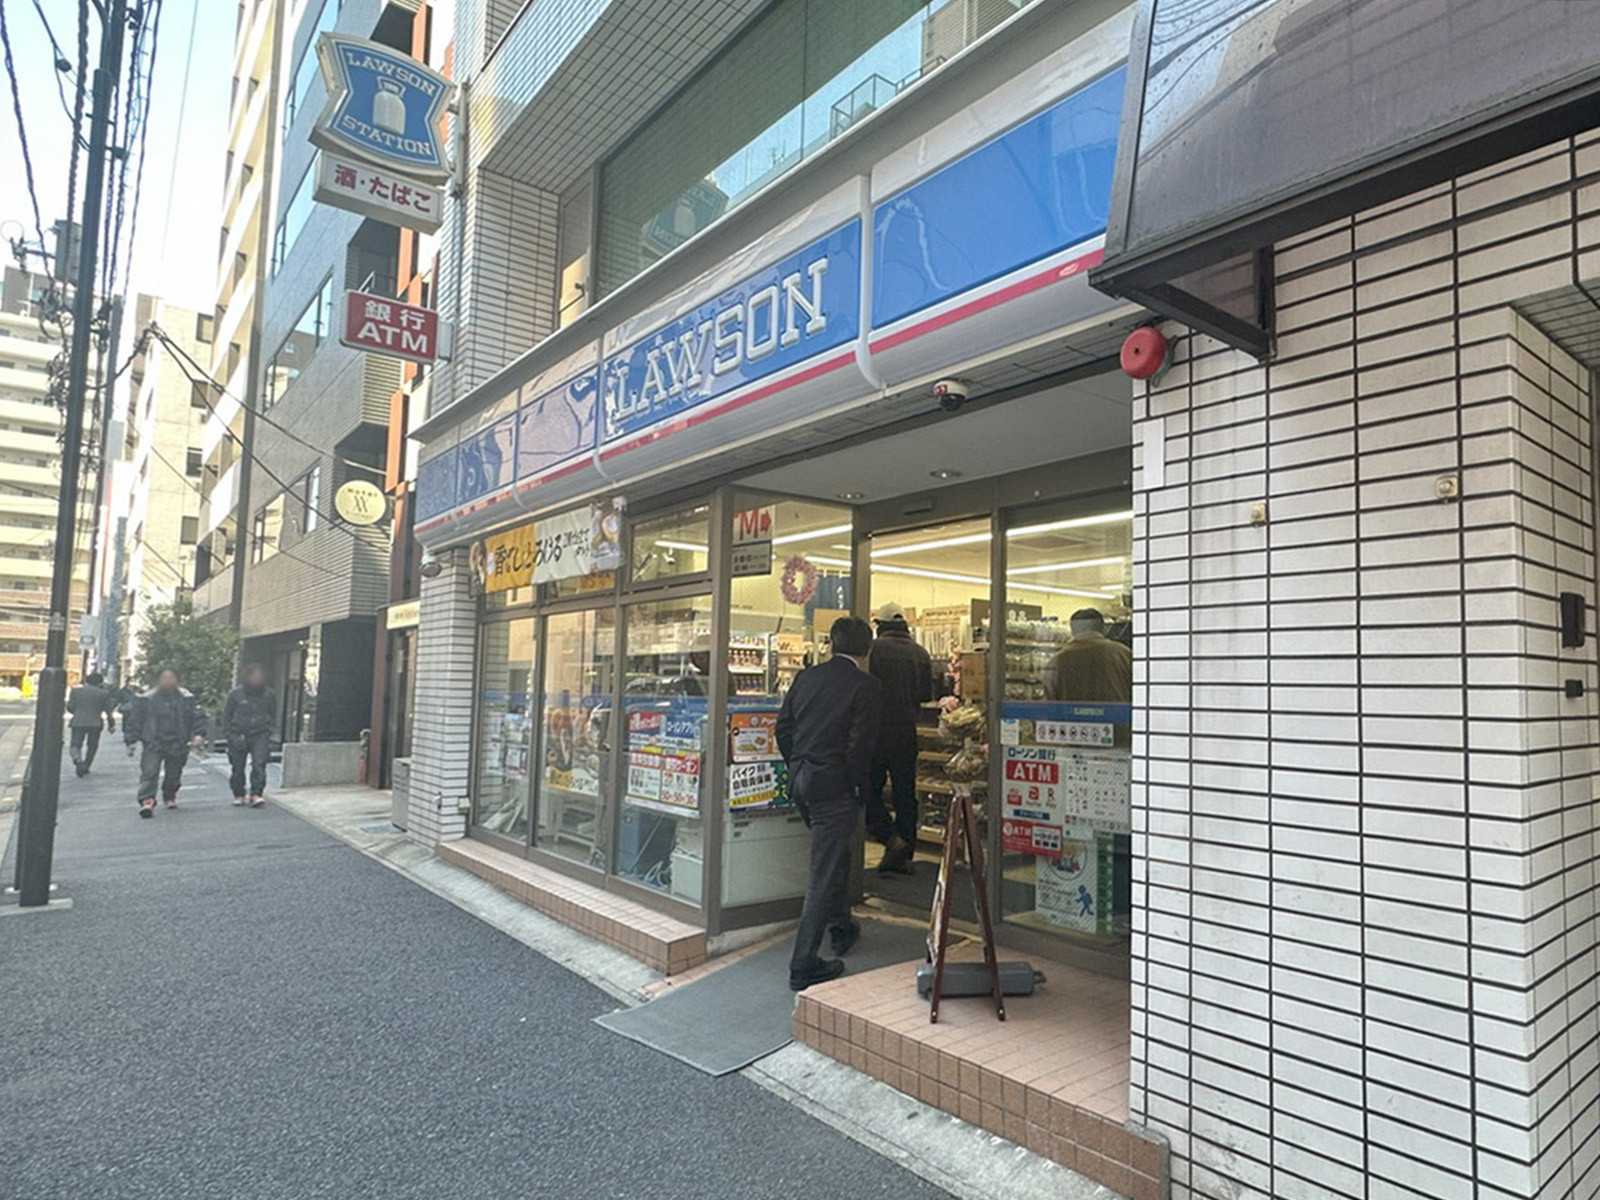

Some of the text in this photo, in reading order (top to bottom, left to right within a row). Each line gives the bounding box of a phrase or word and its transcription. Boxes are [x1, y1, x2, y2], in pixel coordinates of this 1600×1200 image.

[345, 51, 436, 97] LAWSON
[342, 114, 433, 157] STATION
[335, 163, 432, 214] 酒・たばこ
[364, 299, 426, 332] 銀行
[357, 321, 429, 355] ATM
[615, 257, 828, 421] LAWSON
[1008, 746, 1056, 761] ローソン銀行
[732, 765, 756, 780] バイク
[1013, 762, 1052, 782] ATM
[1013, 825, 1031, 837] ATM
